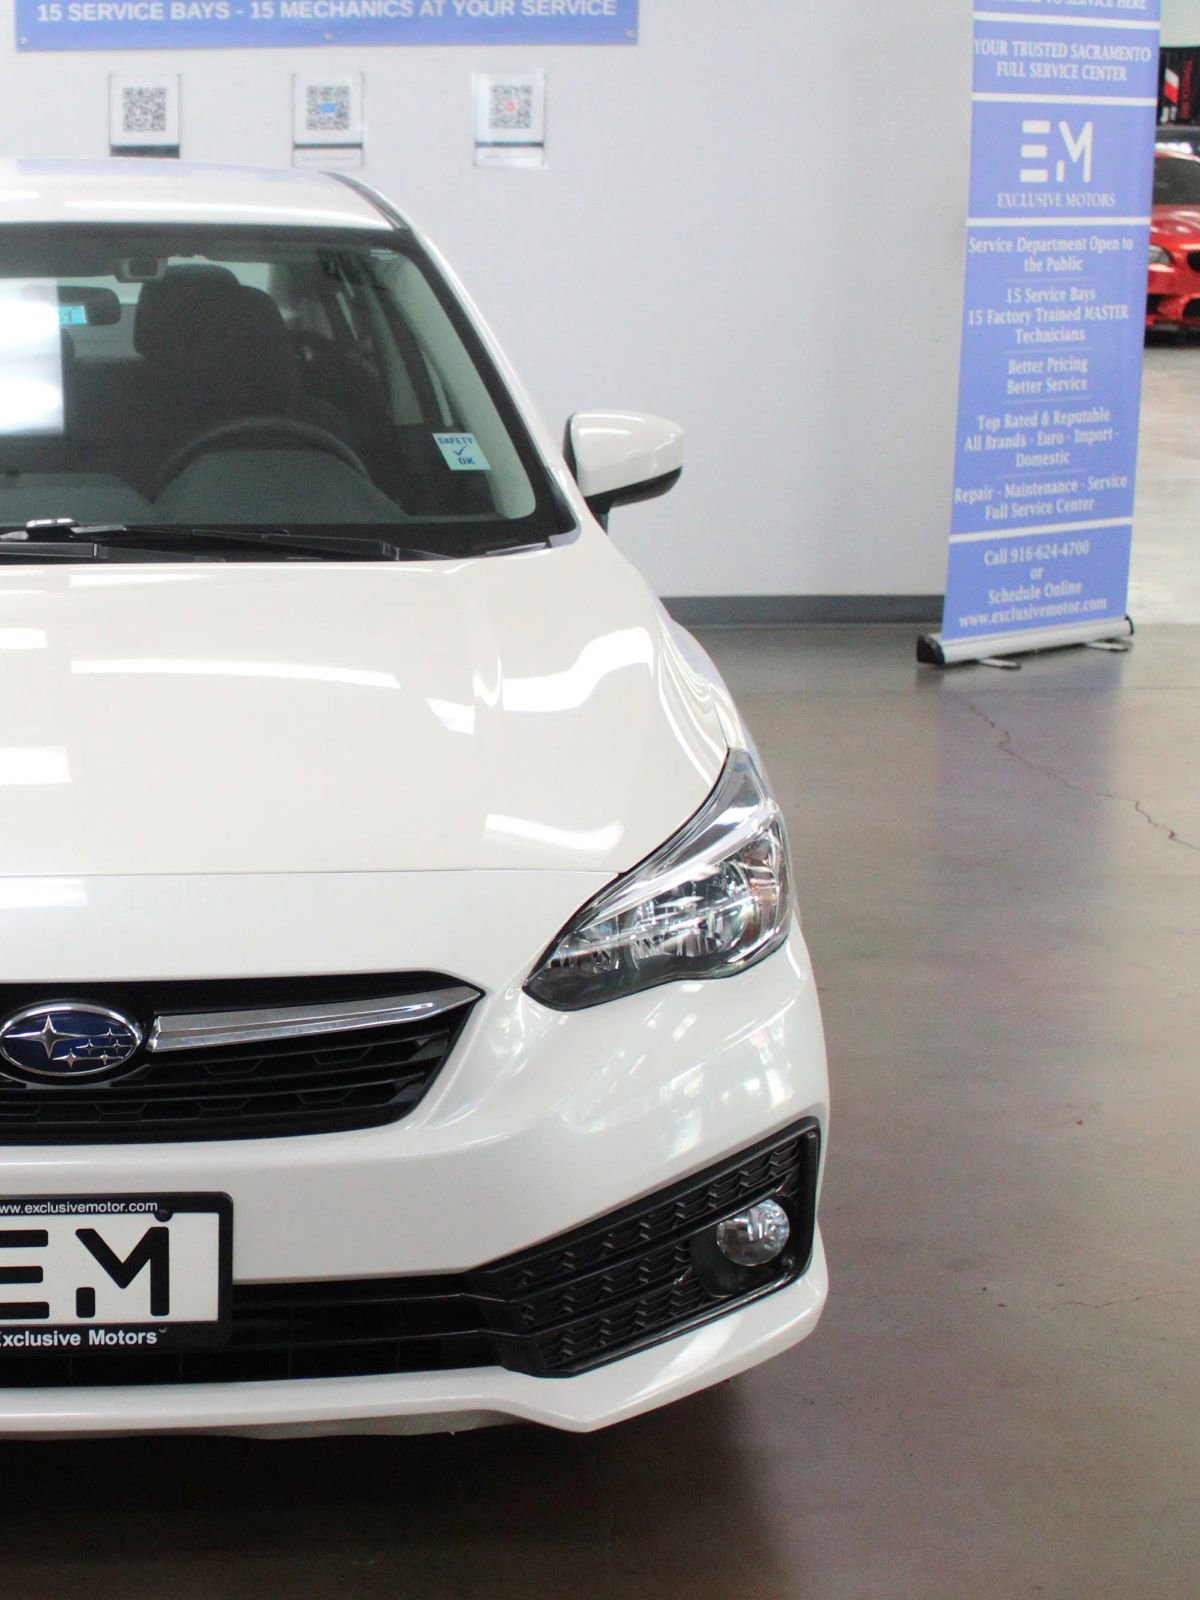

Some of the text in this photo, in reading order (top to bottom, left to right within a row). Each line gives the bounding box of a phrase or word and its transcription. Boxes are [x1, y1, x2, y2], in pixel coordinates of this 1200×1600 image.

[37, 4, 62, 22] 15
[68, 3, 165, 21] SERVICE
[170, 2, 230, 20] BAYS
[251, 2, 274, 19] 15
[280, 0, 413, 19] MECHANICS
[419, 0, 448, 17] AT
[454, 0, 515, 17] YOUR
[521, 0, 617, 17] SERVICE
[974, 38, 1152, 62] YOUR TRUSTED SACRAMENTO
[996, 61, 1128, 81] FULL SERVICE CENTER
[997, 192, 1116, 209] EXCLUSIVE MOTORS
[968, 236, 1134, 255] Service Department Open to
[1023, 256, 1084, 273] the Public
[1006, 286, 1096, 304] 15 Service Bays
[968, 304, 1129, 326] 15 Factory Trained MASTER
[1016, 328, 1085, 344] Technicians
[1008, 357, 1089, 374] Better Pricing
[1007, 376, 1088, 395] Better Service
[977, 415, 1001, 432] Top
[1004, 411, 1038, 429] Rated
[1053, 407, 1111, 426] Reputable
[437, 437, 473, 445] SAFETY
[964, 434, 982, 452] All
[985, 433, 1026, 450] Brands
[1037, 430, 1064, 446] Euro
[1074, 427, 1113, 445] Import
[458, 457, 476, 465] OK
[1015, 450, 1070, 468] Domestic
[954, 486, 993, 504] Repair
[1004, 480, 1078, 499] Maintenance
[1087, 474, 1128, 491] Service
[984, 498, 1095, 521] Full Service Center
[984, 540, 1090, 566] Call 916-624-4700
[1029, 567, 1044, 580] or
[988, 580, 1083, 605] Schedule Online
[959, 597, 1108, 628] www.exclusivemotor.com
[88, 1329, 158, 1346] Motors
